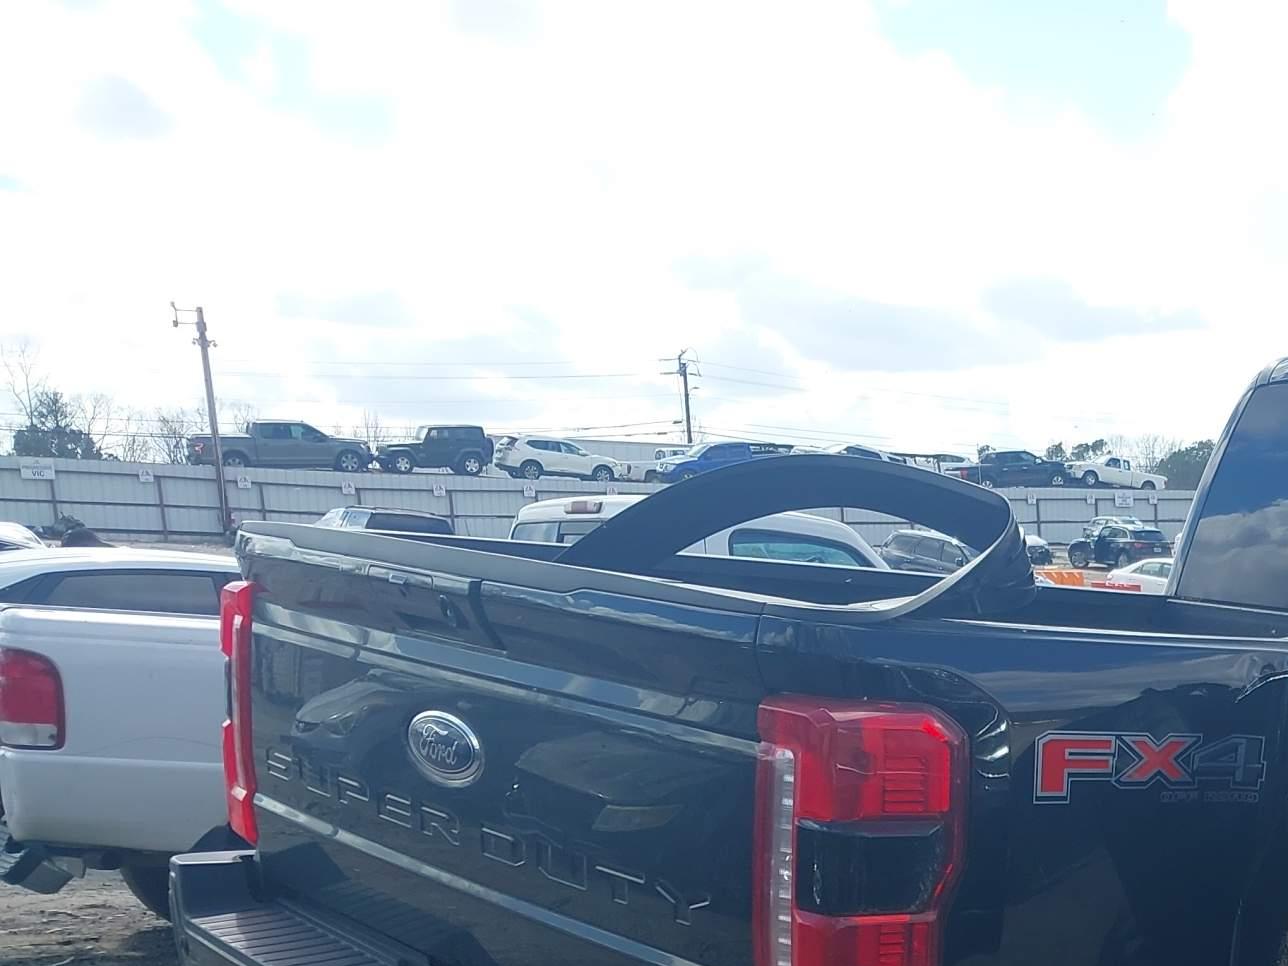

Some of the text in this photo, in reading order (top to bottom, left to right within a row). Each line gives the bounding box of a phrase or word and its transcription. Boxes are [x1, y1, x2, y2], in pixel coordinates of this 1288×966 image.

[419, 723, 458, 766] Ford
[1033, 730, 1266, 804] FX4
[265, 746, 711, 926] SUPER DUTY
